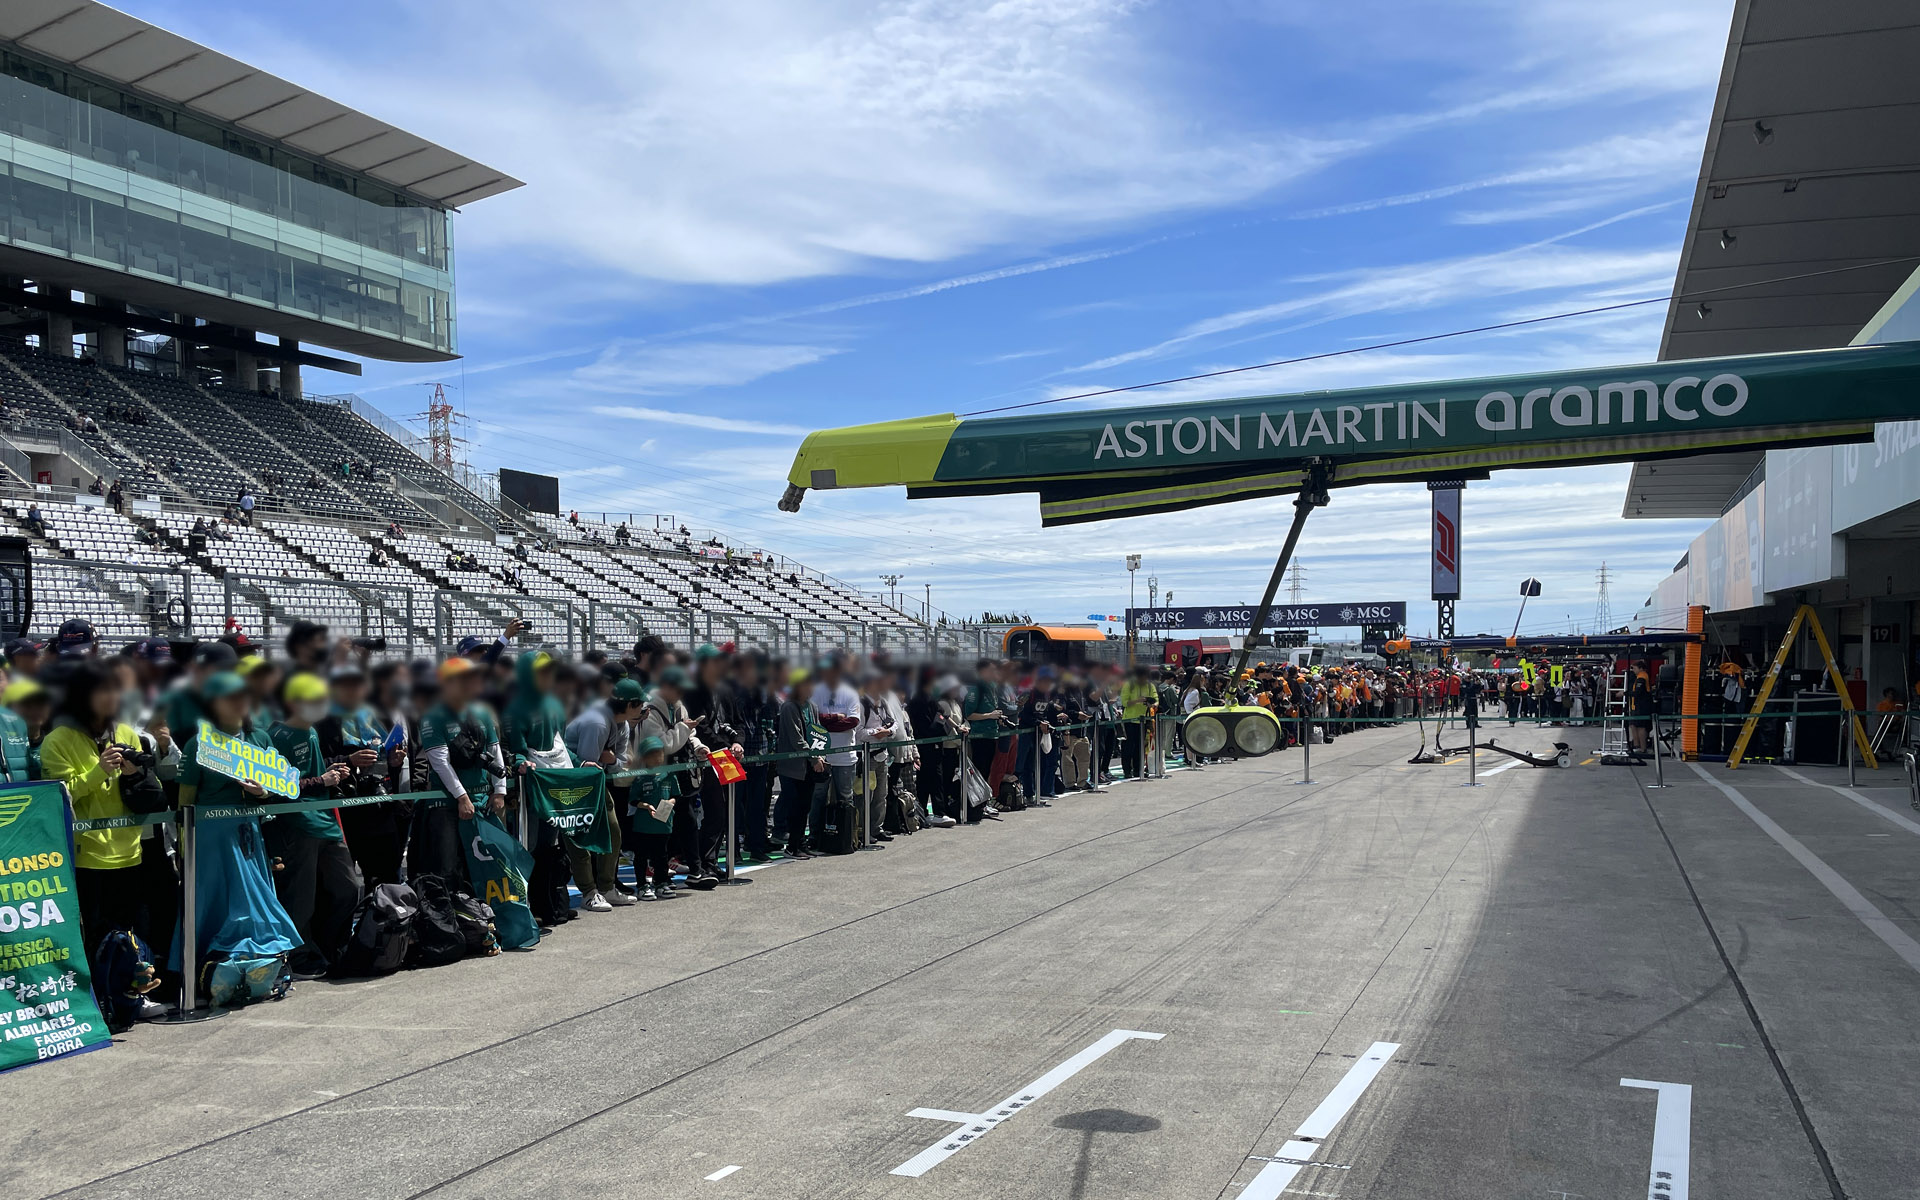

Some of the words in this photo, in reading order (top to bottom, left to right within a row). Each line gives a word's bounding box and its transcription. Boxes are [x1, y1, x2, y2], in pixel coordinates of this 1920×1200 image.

[1094, 414, 1241, 460] ASTON
[1258, 398, 1446, 449] MARTIN
[1475, 373, 1749, 431] aramco
[1875, 421, 1920, 468] STROL
[1155, 611, 1185, 623] MSC
[1219, 610, 1251, 622] MSC
[1287, 608, 1320, 620] MSC
[1357, 606, 1391, 619] MSC
[1872, 628, 1889, 641] 19
[200, 722, 287, 772] Fernando
[200, 743, 232, 762] Spanish
[812, 738, 827, 750] 14
[199, 753, 233, 775] Samurai
[234, 760, 298, 797] Alonso
[342, 798, 365, 806] ASTON
[366, 795, 393, 804] MARTIN
[204, 808, 232, 818] ASTON
[234, 806, 266, 817] MARTIN
[96, 816, 136, 829] MARTIN
[0, 899, 65, 933] OSA
[16, 998, 70, 1022] BROWN
[4, 1013, 76, 1041] ALBILARES
[34, 1022, 92, 1048] FABRIZIO
[38, 1037, 85, 1060] BORRA
